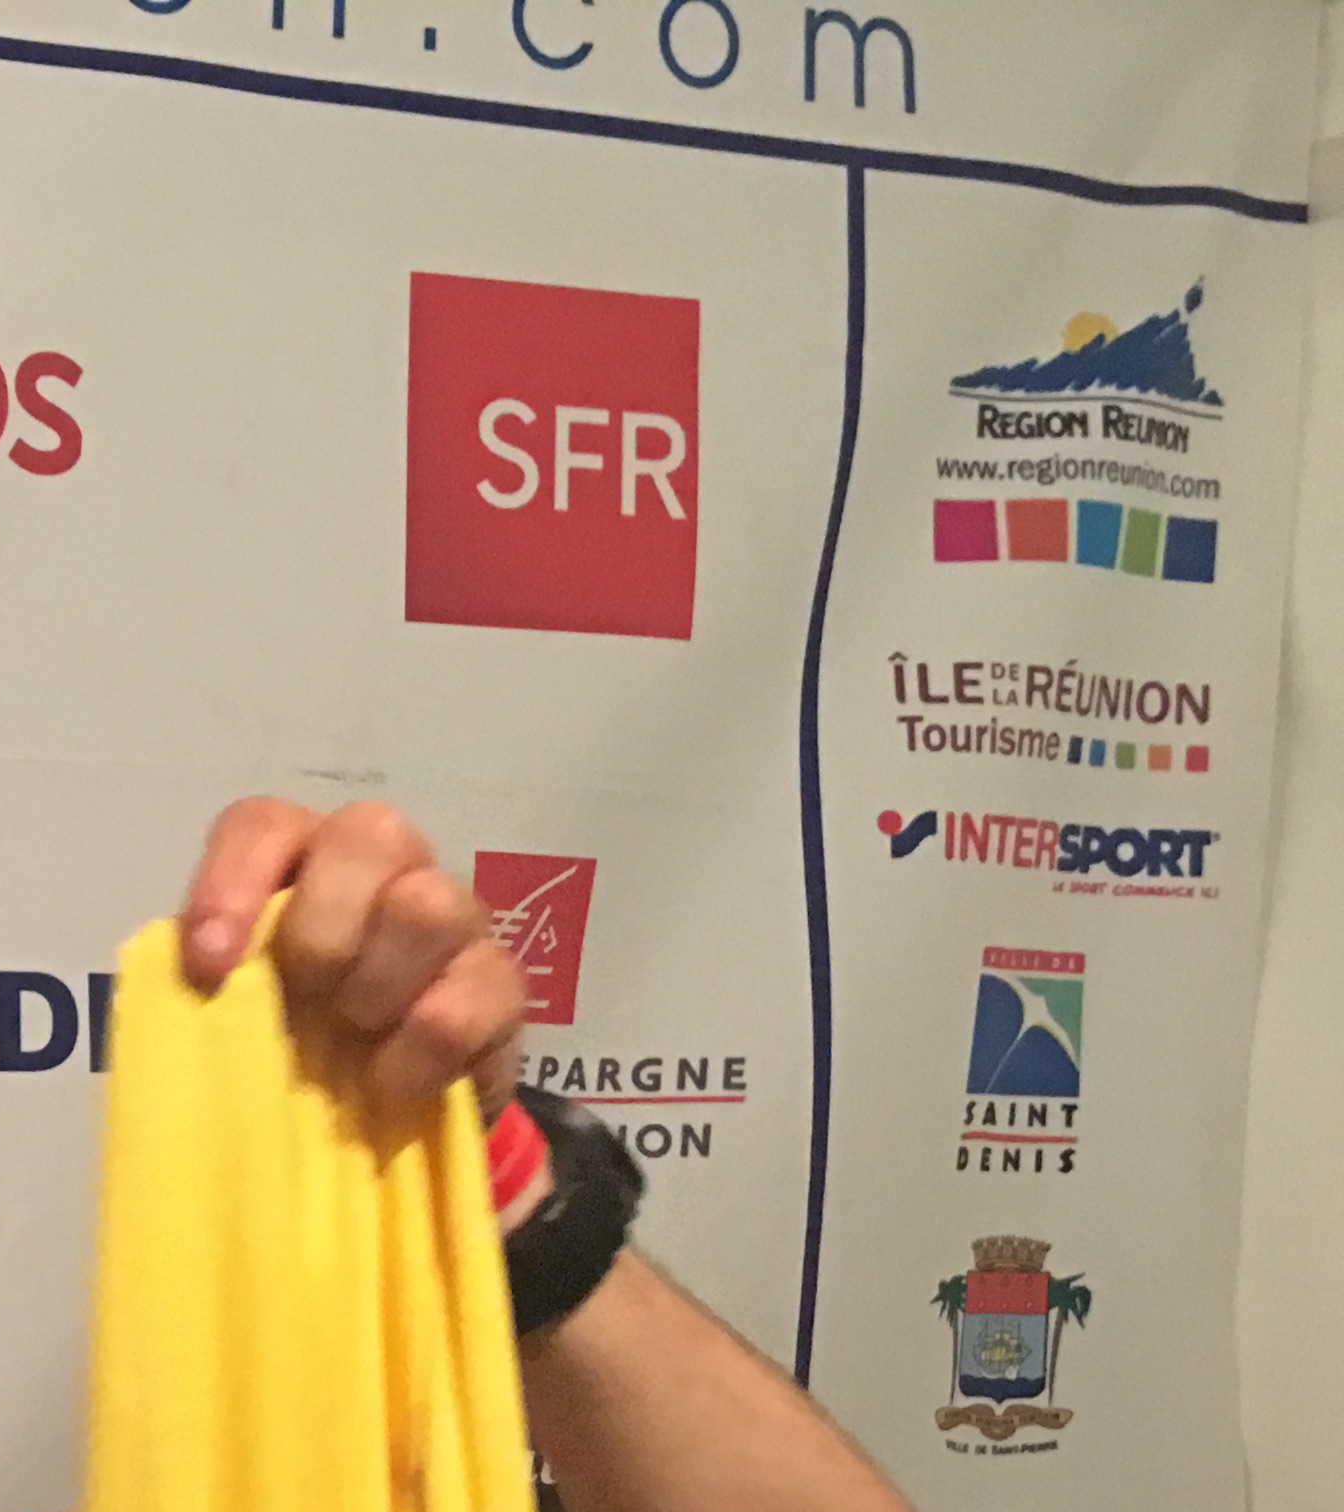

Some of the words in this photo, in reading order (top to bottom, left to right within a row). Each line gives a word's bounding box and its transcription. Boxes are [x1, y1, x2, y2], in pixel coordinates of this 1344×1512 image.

[977, 404, 1088, 439] REGION
[1102, 406, 1189, 453] REUNION
[476, 398, 688, 520] SFR
[937, 455, 1221, 499] www.regionreunion.com
[888, 652, 984, 704] ÎLE
[992, 662, 1020, 681] DE
[1025, 660, 1210, 725] RÉUNION
[992, 690, 1019, 707] LA
[898, 715, 1060, 761] Tourisme
[944, 811, 1213, 878] INTERSPORT
[964, 1101, 1078, 1127] SAINT
[956, 1147, 1076, 1173] DENIS
